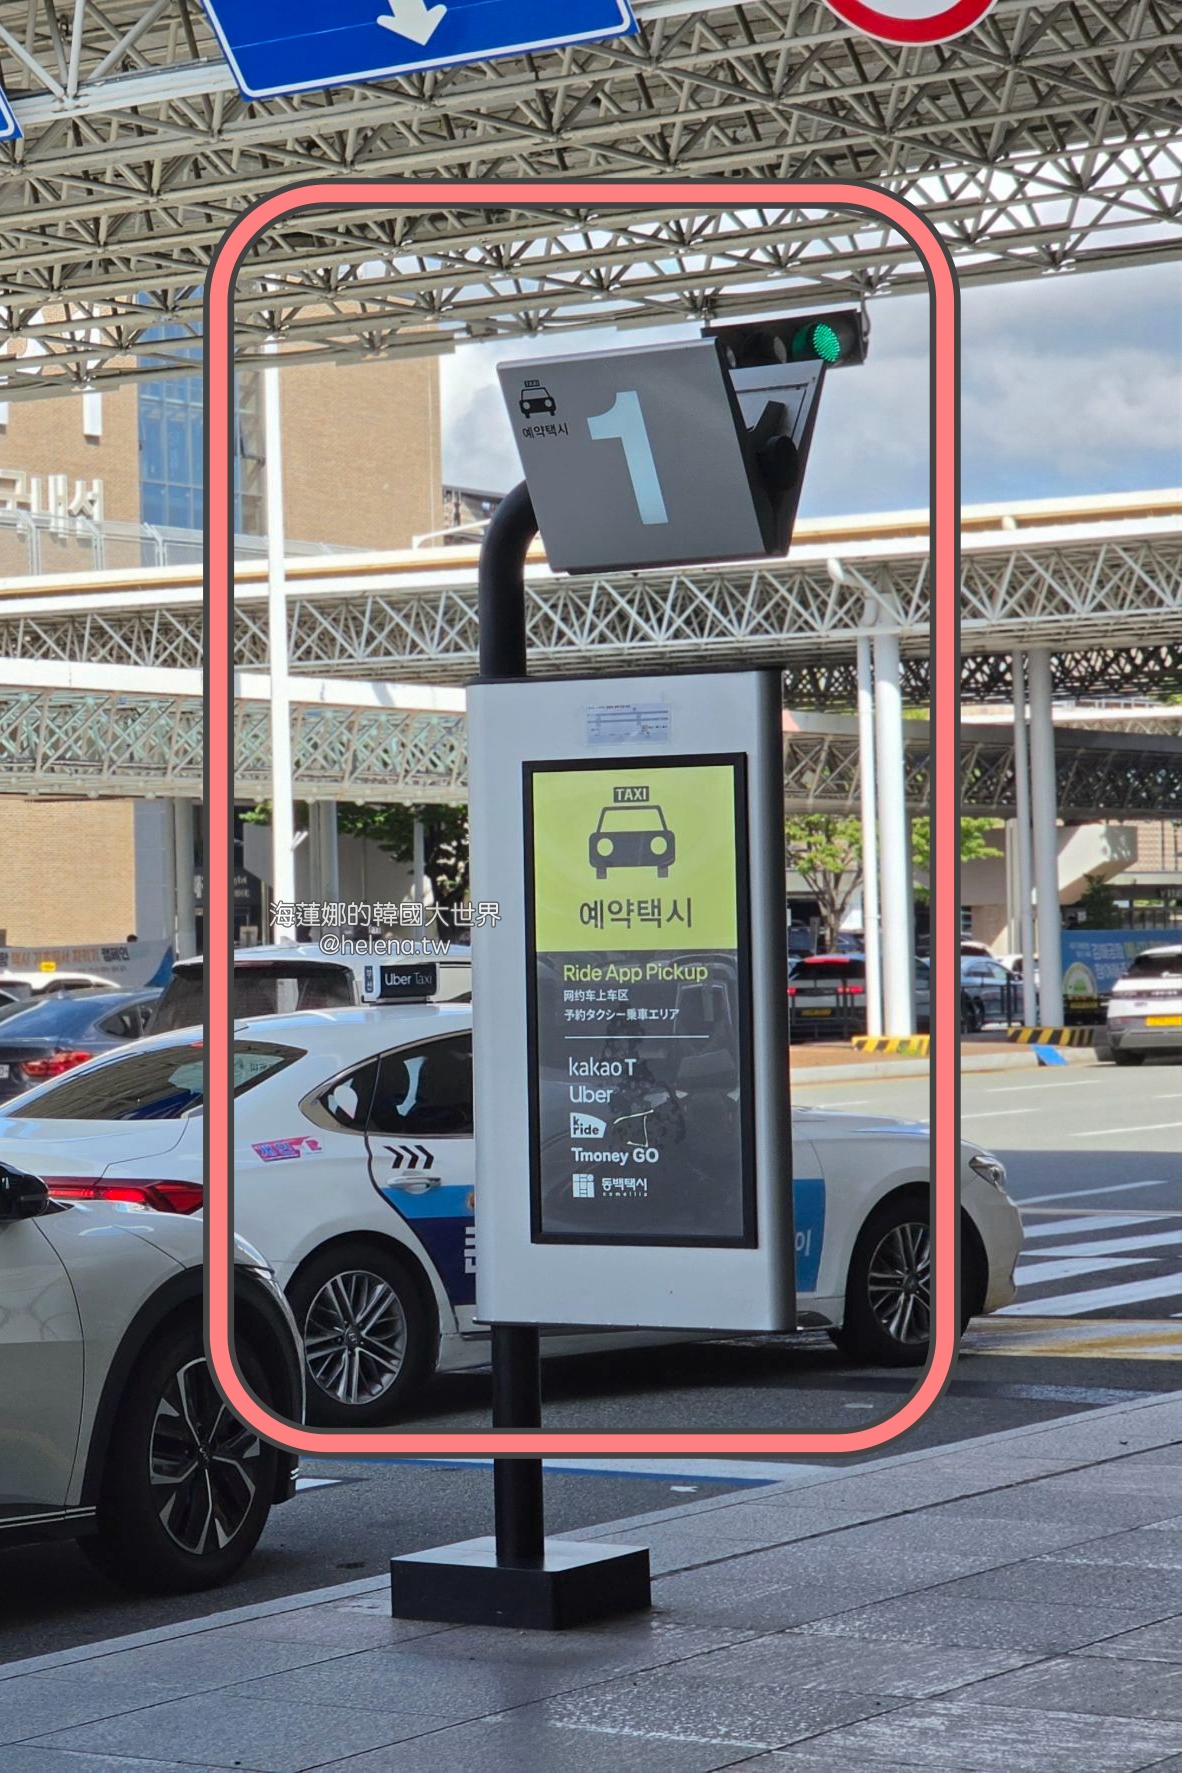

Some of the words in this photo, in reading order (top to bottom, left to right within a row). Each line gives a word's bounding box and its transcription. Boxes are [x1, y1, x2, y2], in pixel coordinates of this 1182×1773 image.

[522, 421, 569, 439] 예약택시
[587, 390, 669, 525] 1
[615, 788, 648, 801] TAXI
[579, 897, 693, 930] 예약택시
[384, 972, 412, 986] Uber
[413, 972, 432, 985] Taxi
[563, 964, 603, 982] Ride
[605, 964, 643, 983] App
[646, 962, 708, 982] Pickup
[563, 989, 629, 1002] 网约车上车区
[564, 1008, 680, 1021] 予約タクシー乗車エリア
[568, 1056, 622, 1076] kakao
[624, 1058, 637, 1075] T
[569, 1085, 614, 1103] Uber
[573, 1123, 599, 1135] ride
[571, 1147, 629, 1166] Tmoney
[632, 1148, 659, 1163] GO
[602, 1177, 648, 1191] 동백택시
